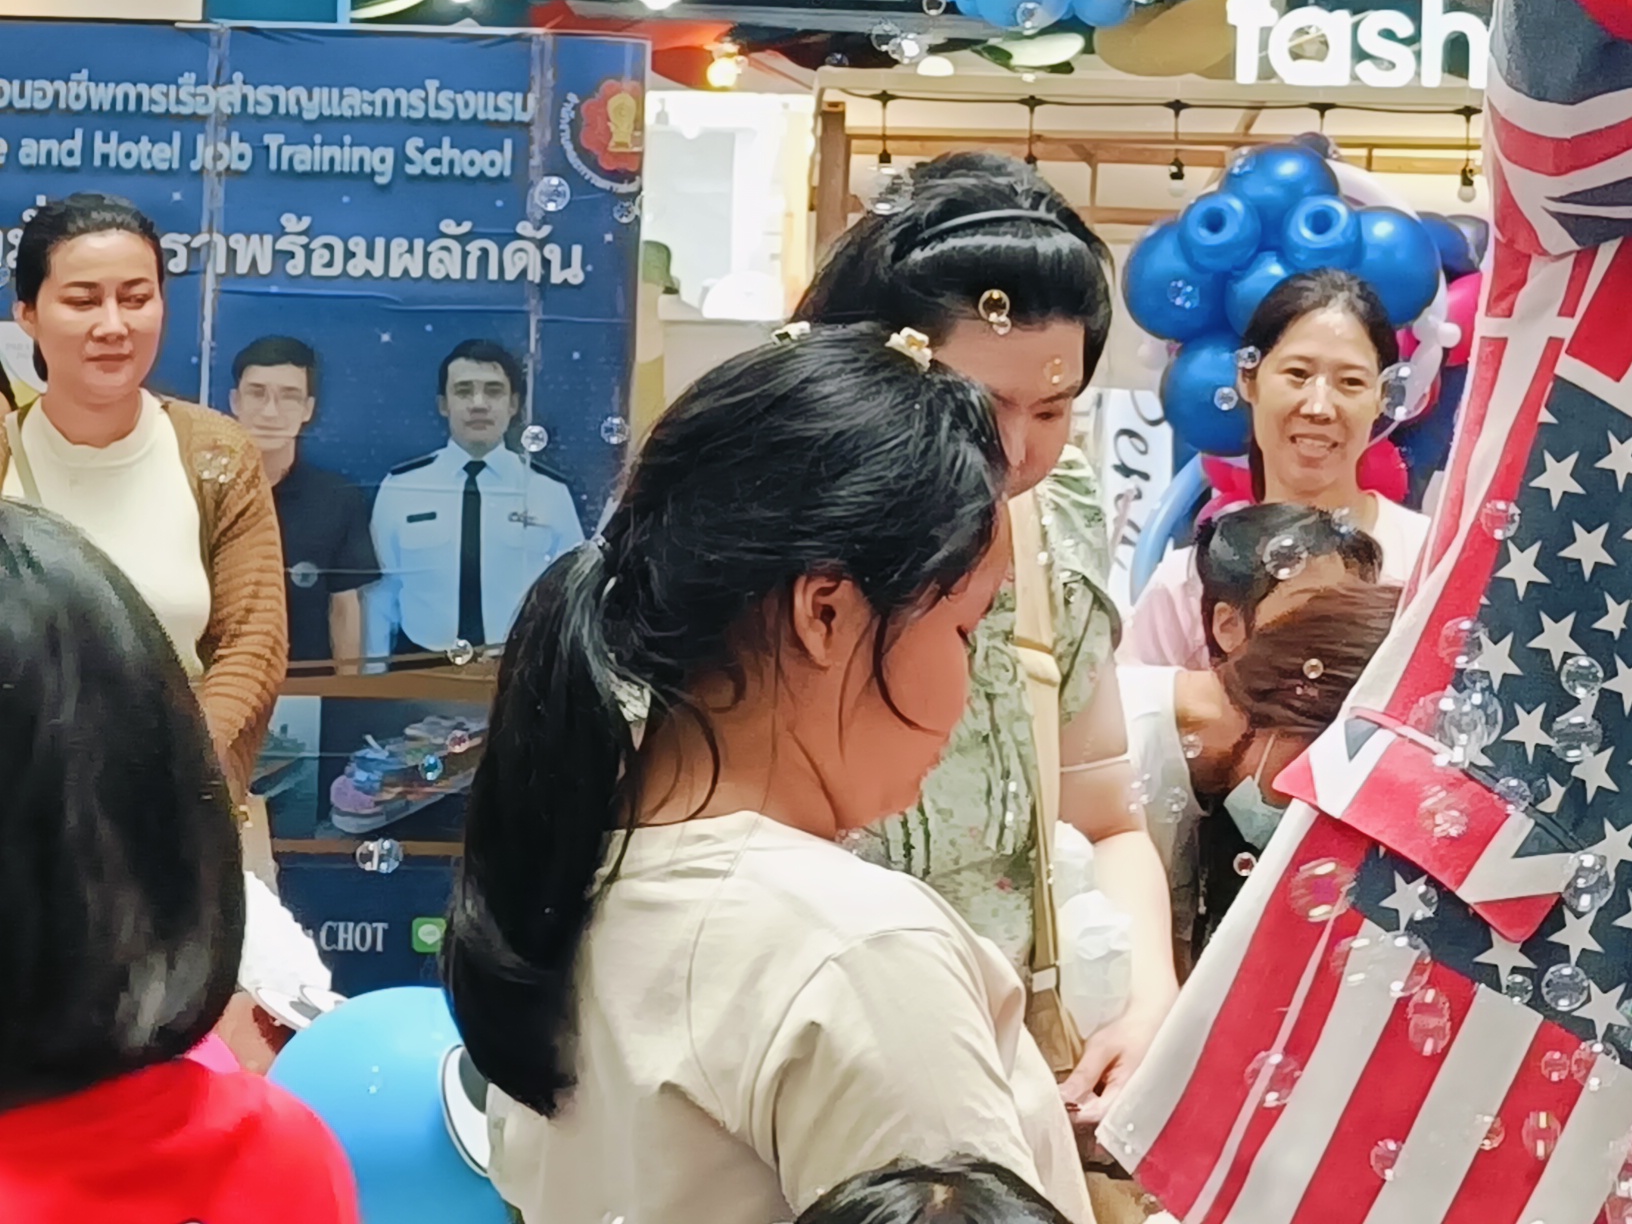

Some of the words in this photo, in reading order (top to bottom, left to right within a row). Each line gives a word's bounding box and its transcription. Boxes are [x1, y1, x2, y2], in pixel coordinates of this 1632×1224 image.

[18, 127, 84, 168] and
[93, 130, 181, 171] Hotel
[189, 131, 253, 172] Job
[263, 133, 395, 186] Training
[404, 136, 512, 178] School
[319, 920, 389, 953] CHOT
